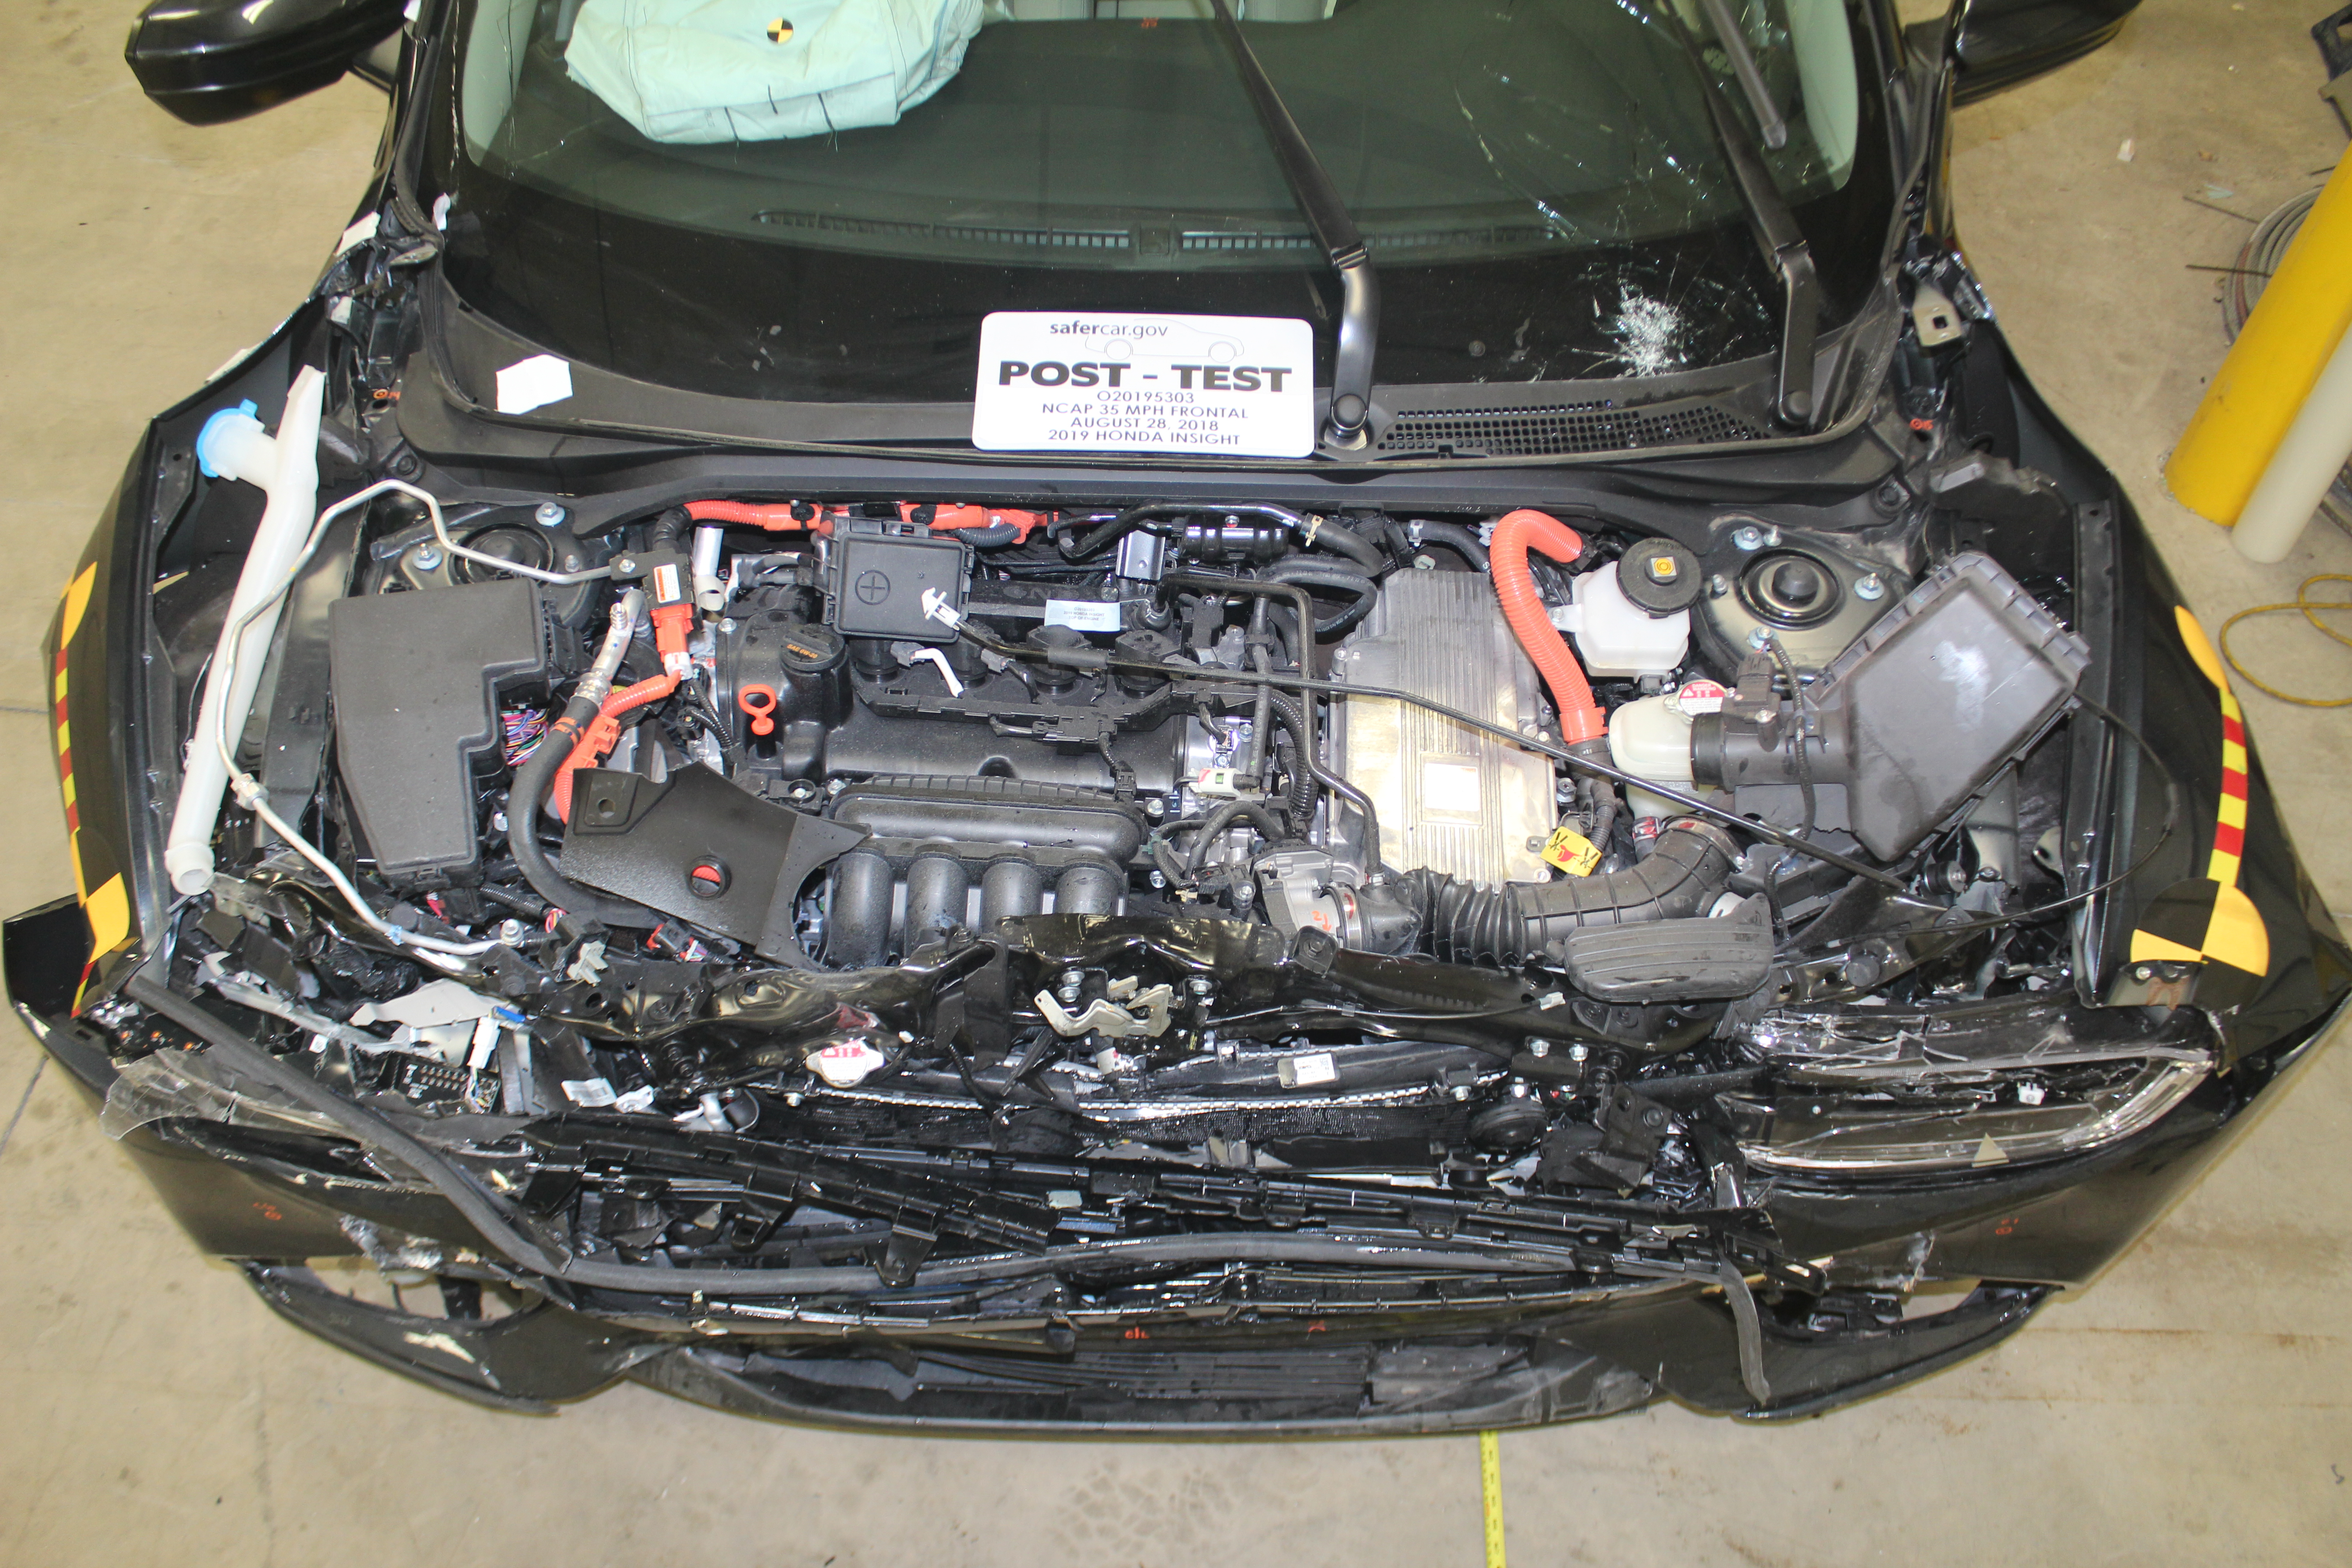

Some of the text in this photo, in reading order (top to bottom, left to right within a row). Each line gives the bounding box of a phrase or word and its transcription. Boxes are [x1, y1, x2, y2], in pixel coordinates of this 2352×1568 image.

[1050, 320, 1168, 338] safercar.gov
[999, 361, 1131, 387] POST
[1171, 365, 1292, 392] TEST
[1042, 403, 1248, 418] NCAP 35 MPH FRONTAL
[1071, 417, 1218, 431] AUGUST 28, 2018
[1049, 430, 1240, 445] 2019 HONDA INSIGHT
[787, 644, 800, 652] SAE
